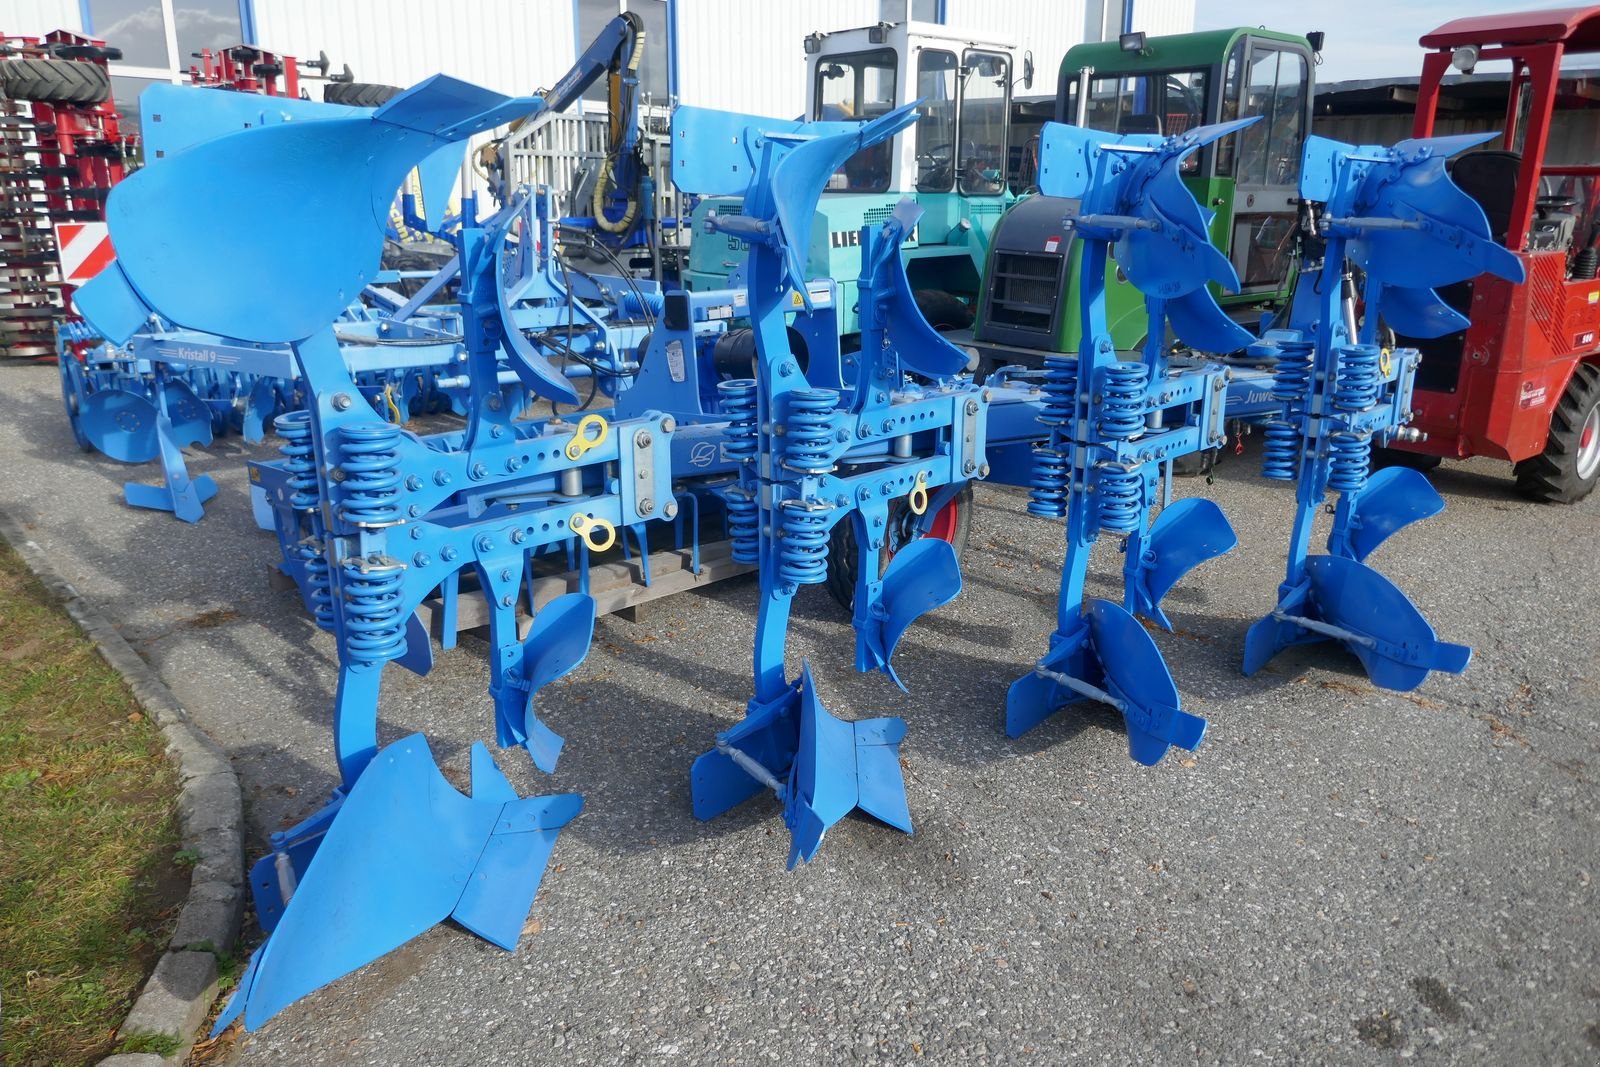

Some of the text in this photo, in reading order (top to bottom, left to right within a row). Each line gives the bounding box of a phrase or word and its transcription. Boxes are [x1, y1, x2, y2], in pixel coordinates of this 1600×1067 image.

[178, 347, 216, 363] Kristall 9
[1244, 390, 1275, 404] Juwe
